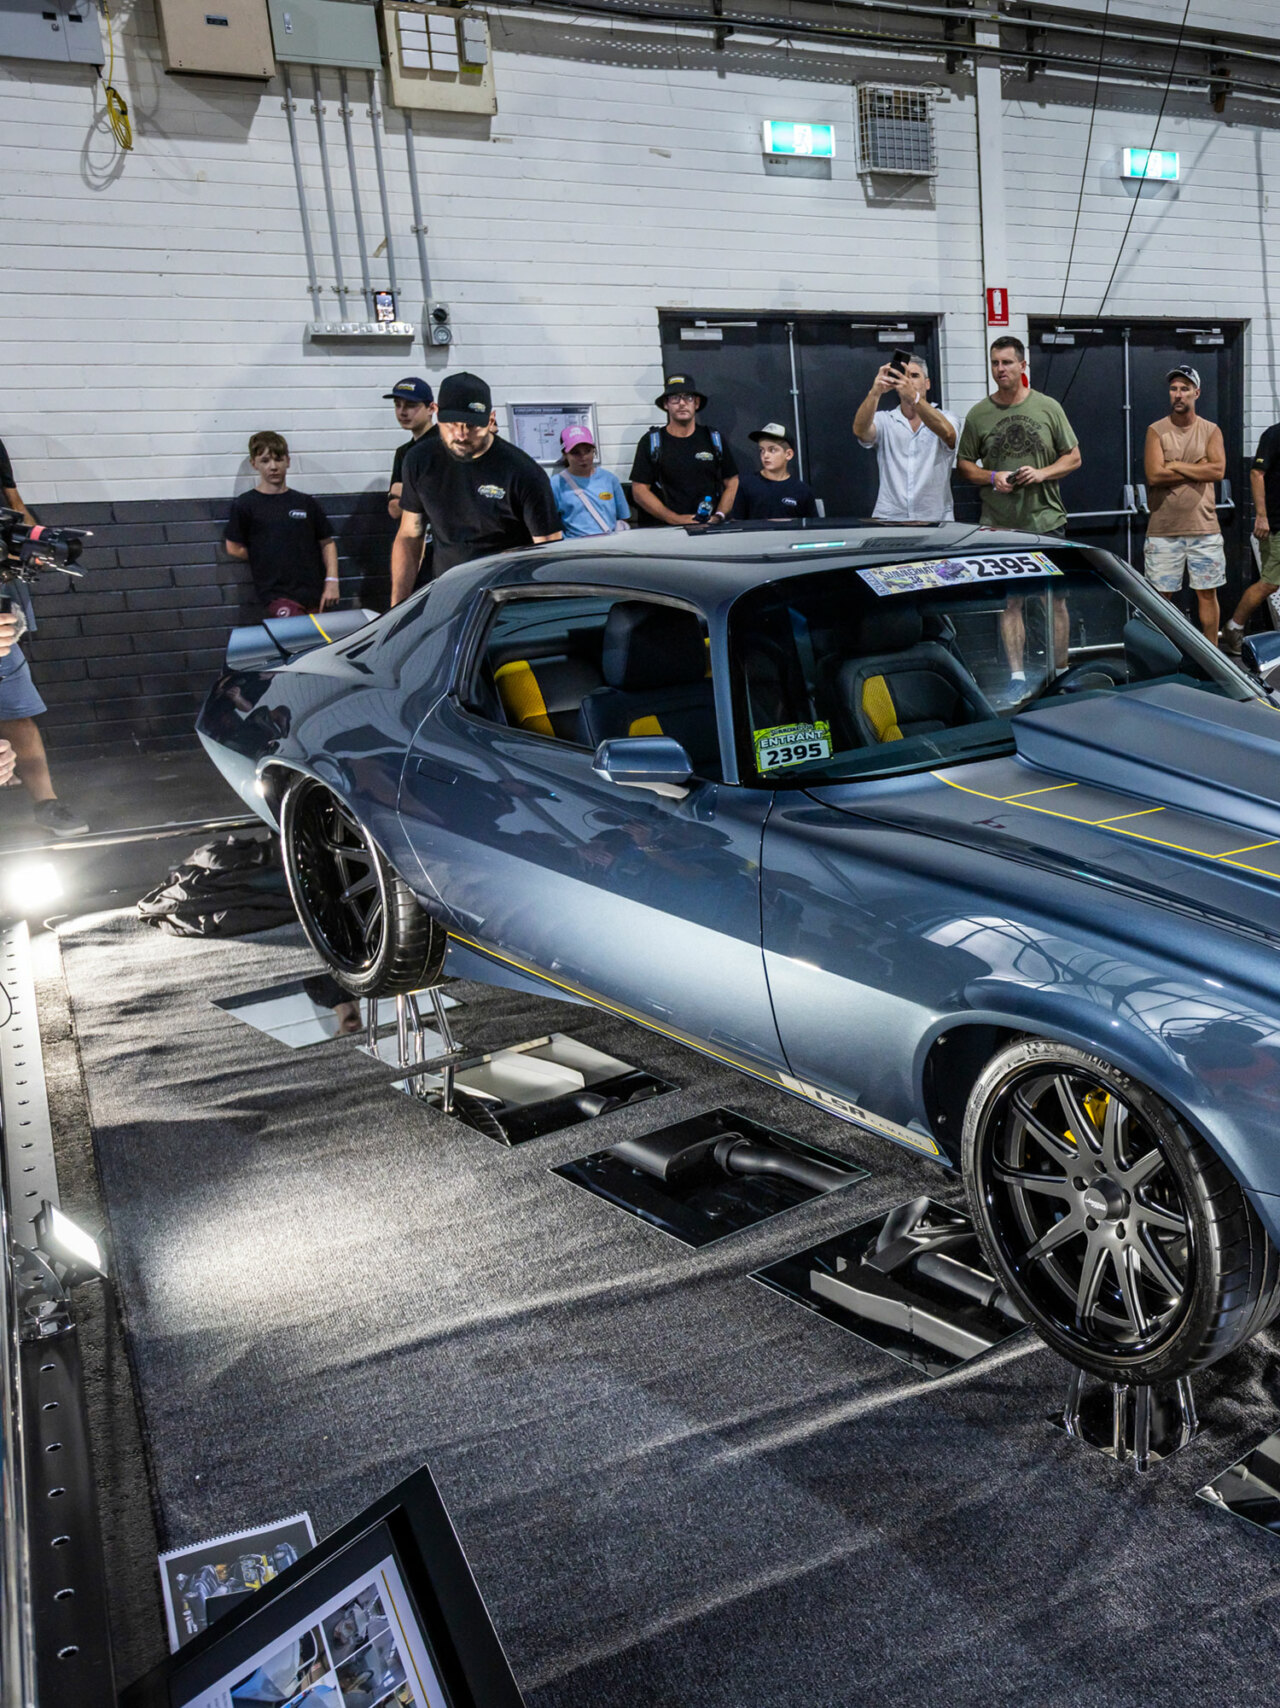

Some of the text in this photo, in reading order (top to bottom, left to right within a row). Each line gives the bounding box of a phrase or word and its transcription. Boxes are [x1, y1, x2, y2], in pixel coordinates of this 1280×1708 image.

[966, 556, 1042, 577] 2395
[761, 730, 824, 748] ENTRANT
[767, 743, 822, 766] 2395
